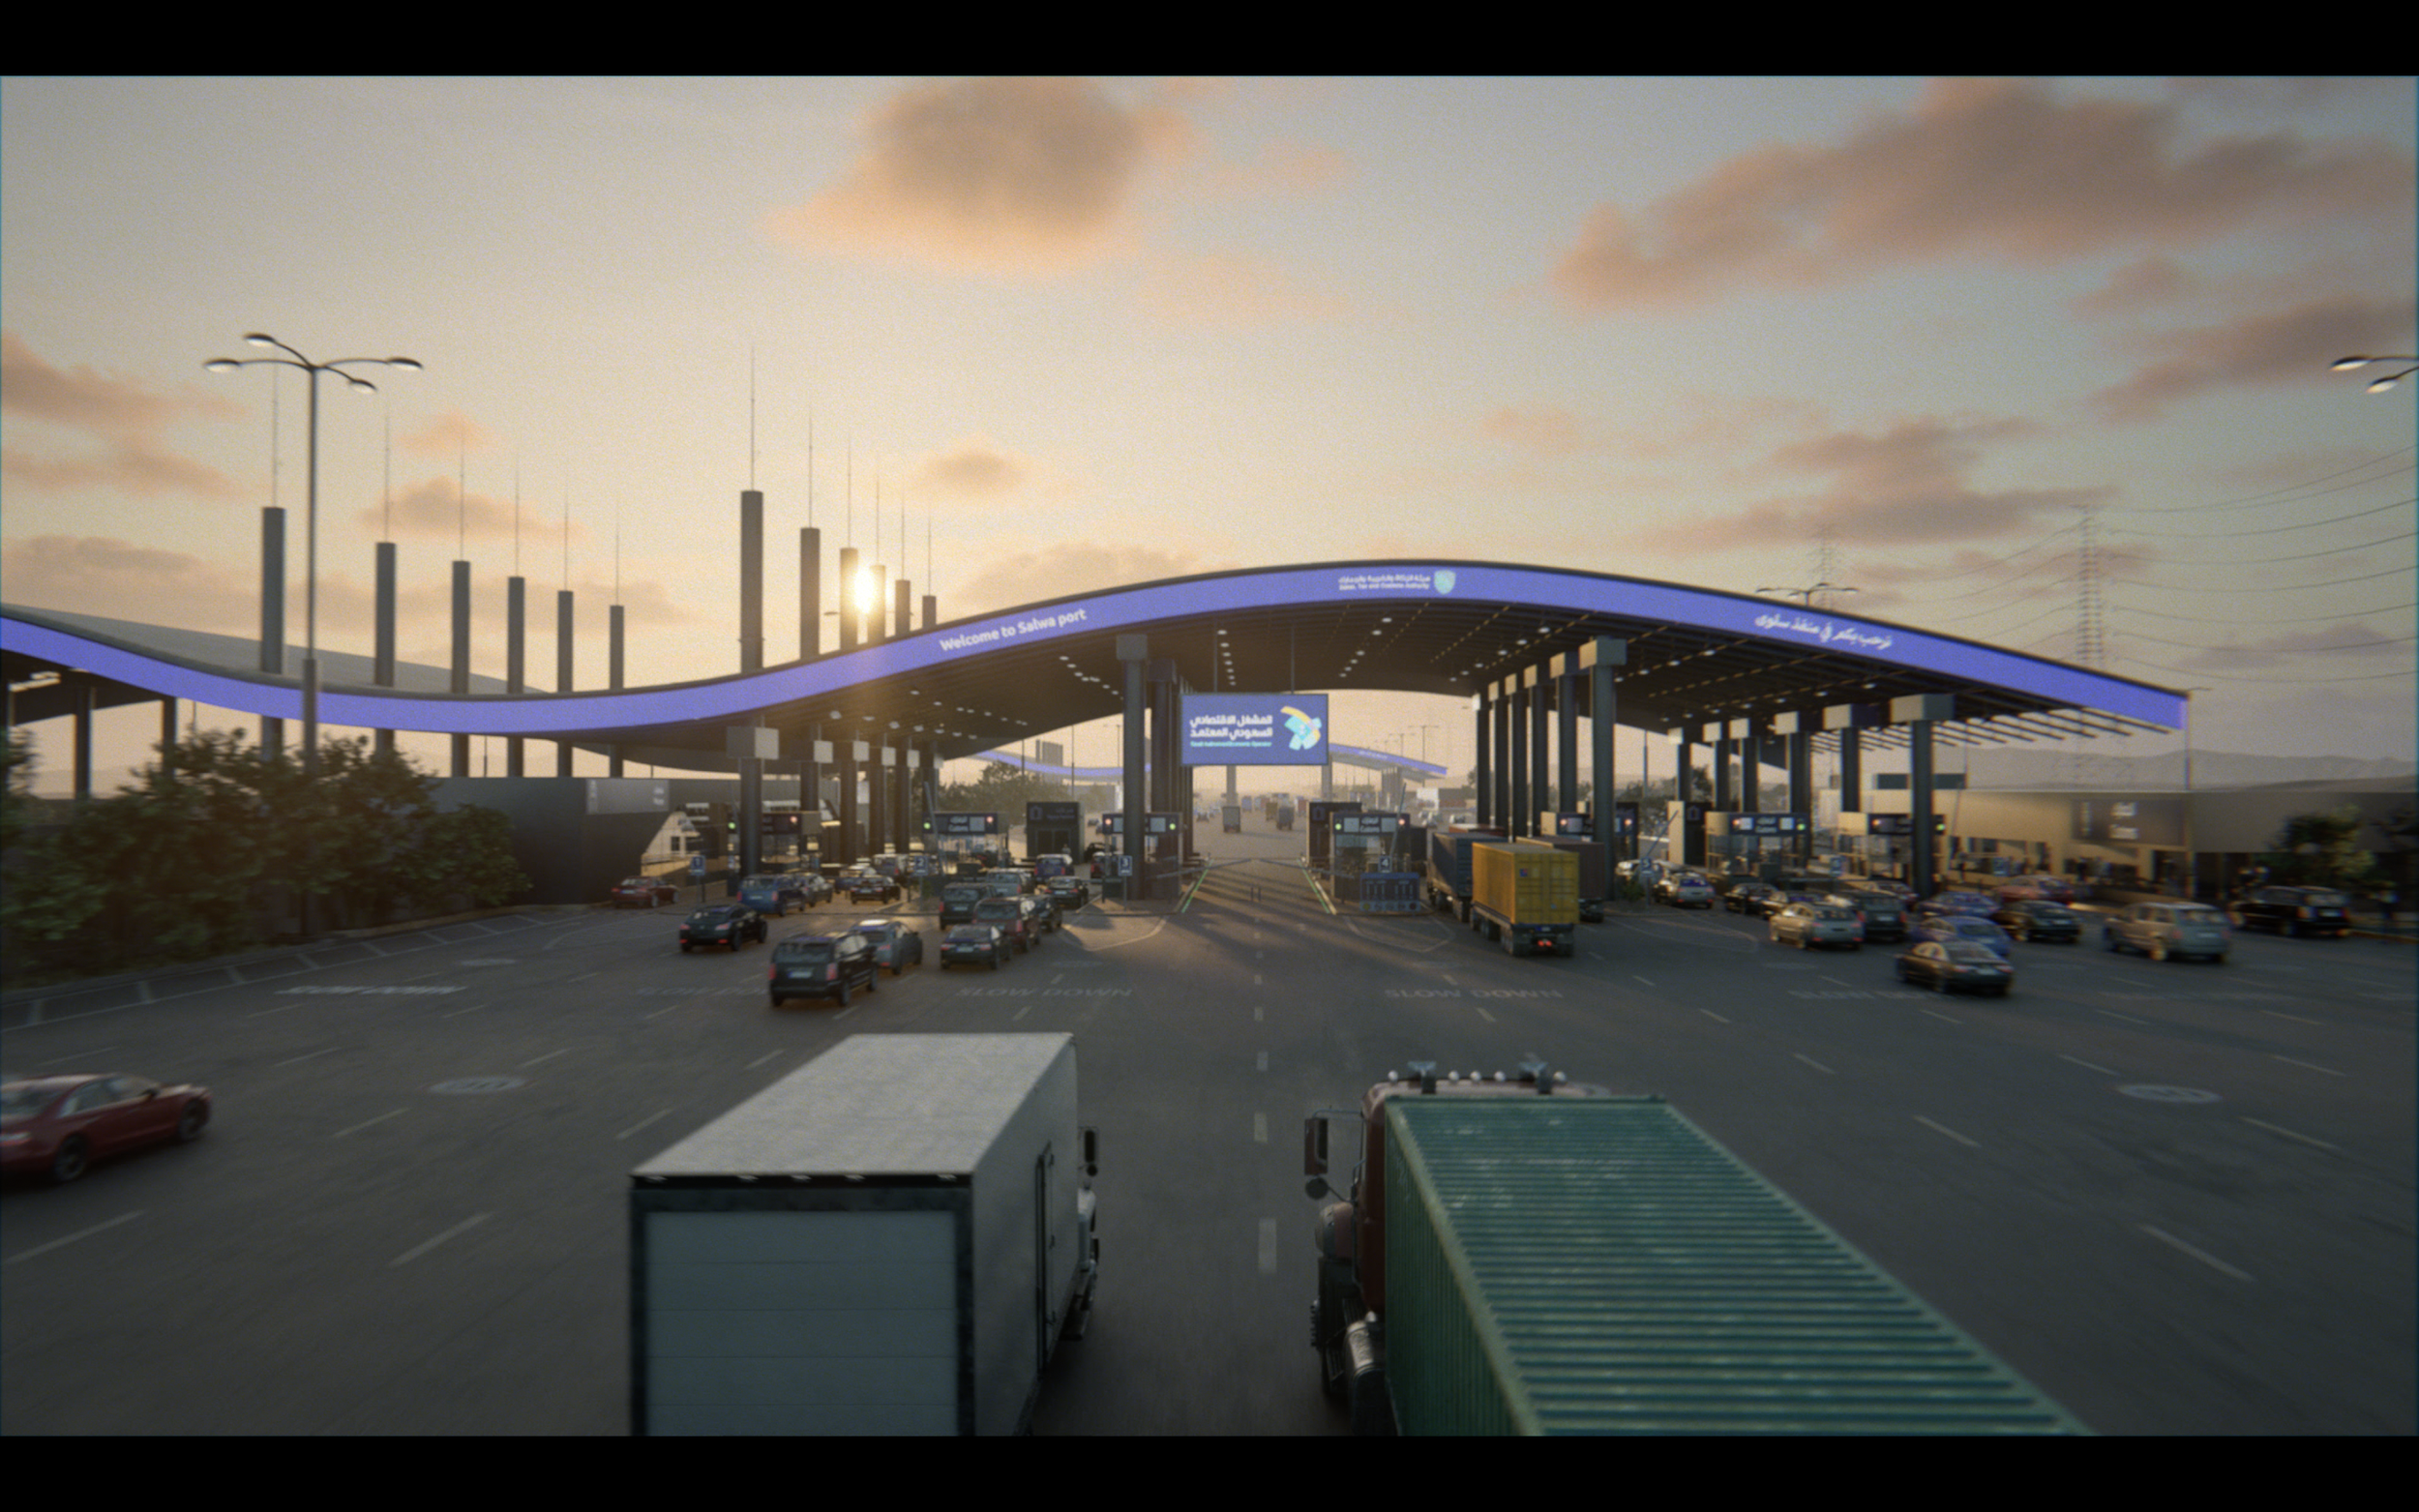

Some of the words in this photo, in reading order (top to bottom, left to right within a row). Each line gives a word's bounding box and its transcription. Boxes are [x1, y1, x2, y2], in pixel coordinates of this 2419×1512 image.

[939, 630, 1000, 651] Welcome
[1000, 626, 1016, 638] to
[1017, 617, 1057, 635] Salwa
[1058, 608, 1088, 628] port
[1189, 714, 1237, 728] الاقتصادي
[1237, 714, 1273, 727] المشغل
[1190, 727, 1229, 737] المعتمد
[1229, 727, 1273, 741] السعودي
[955, 987, 1037, 996] SLOW
[1042, 987, 1132, 996] DOWN
[1384, 989, 1461, 998] SLOW
[1469, 989, 1564, 998] DOWN
